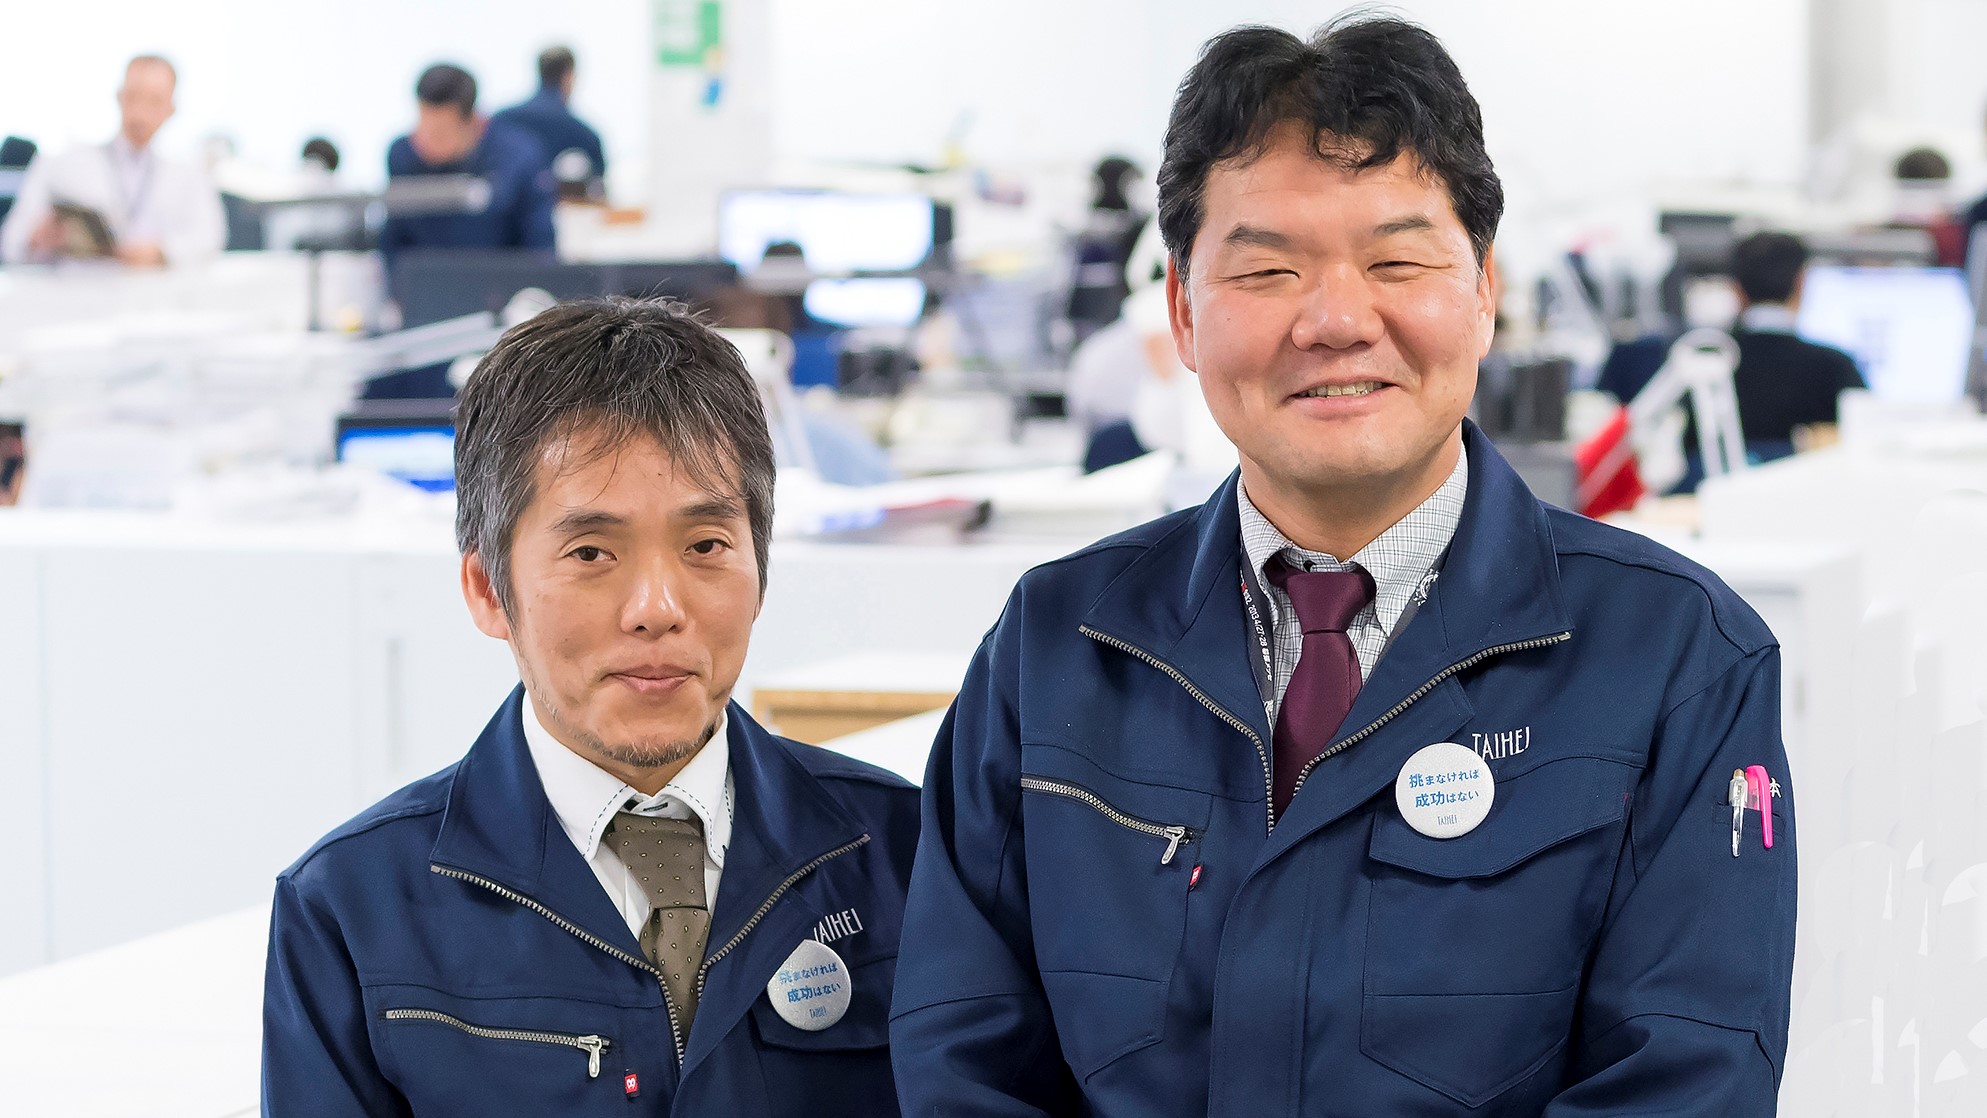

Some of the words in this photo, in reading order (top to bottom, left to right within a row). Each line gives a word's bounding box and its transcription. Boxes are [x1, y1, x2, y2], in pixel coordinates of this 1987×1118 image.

[1471, 726, 1530, 760] TAIHEI
[1409, 769, 1479, 788] 挑まなければ
[1415, 790, 1479, 808] 成功はない
[787, 983, 841, 1002] 成功はない
